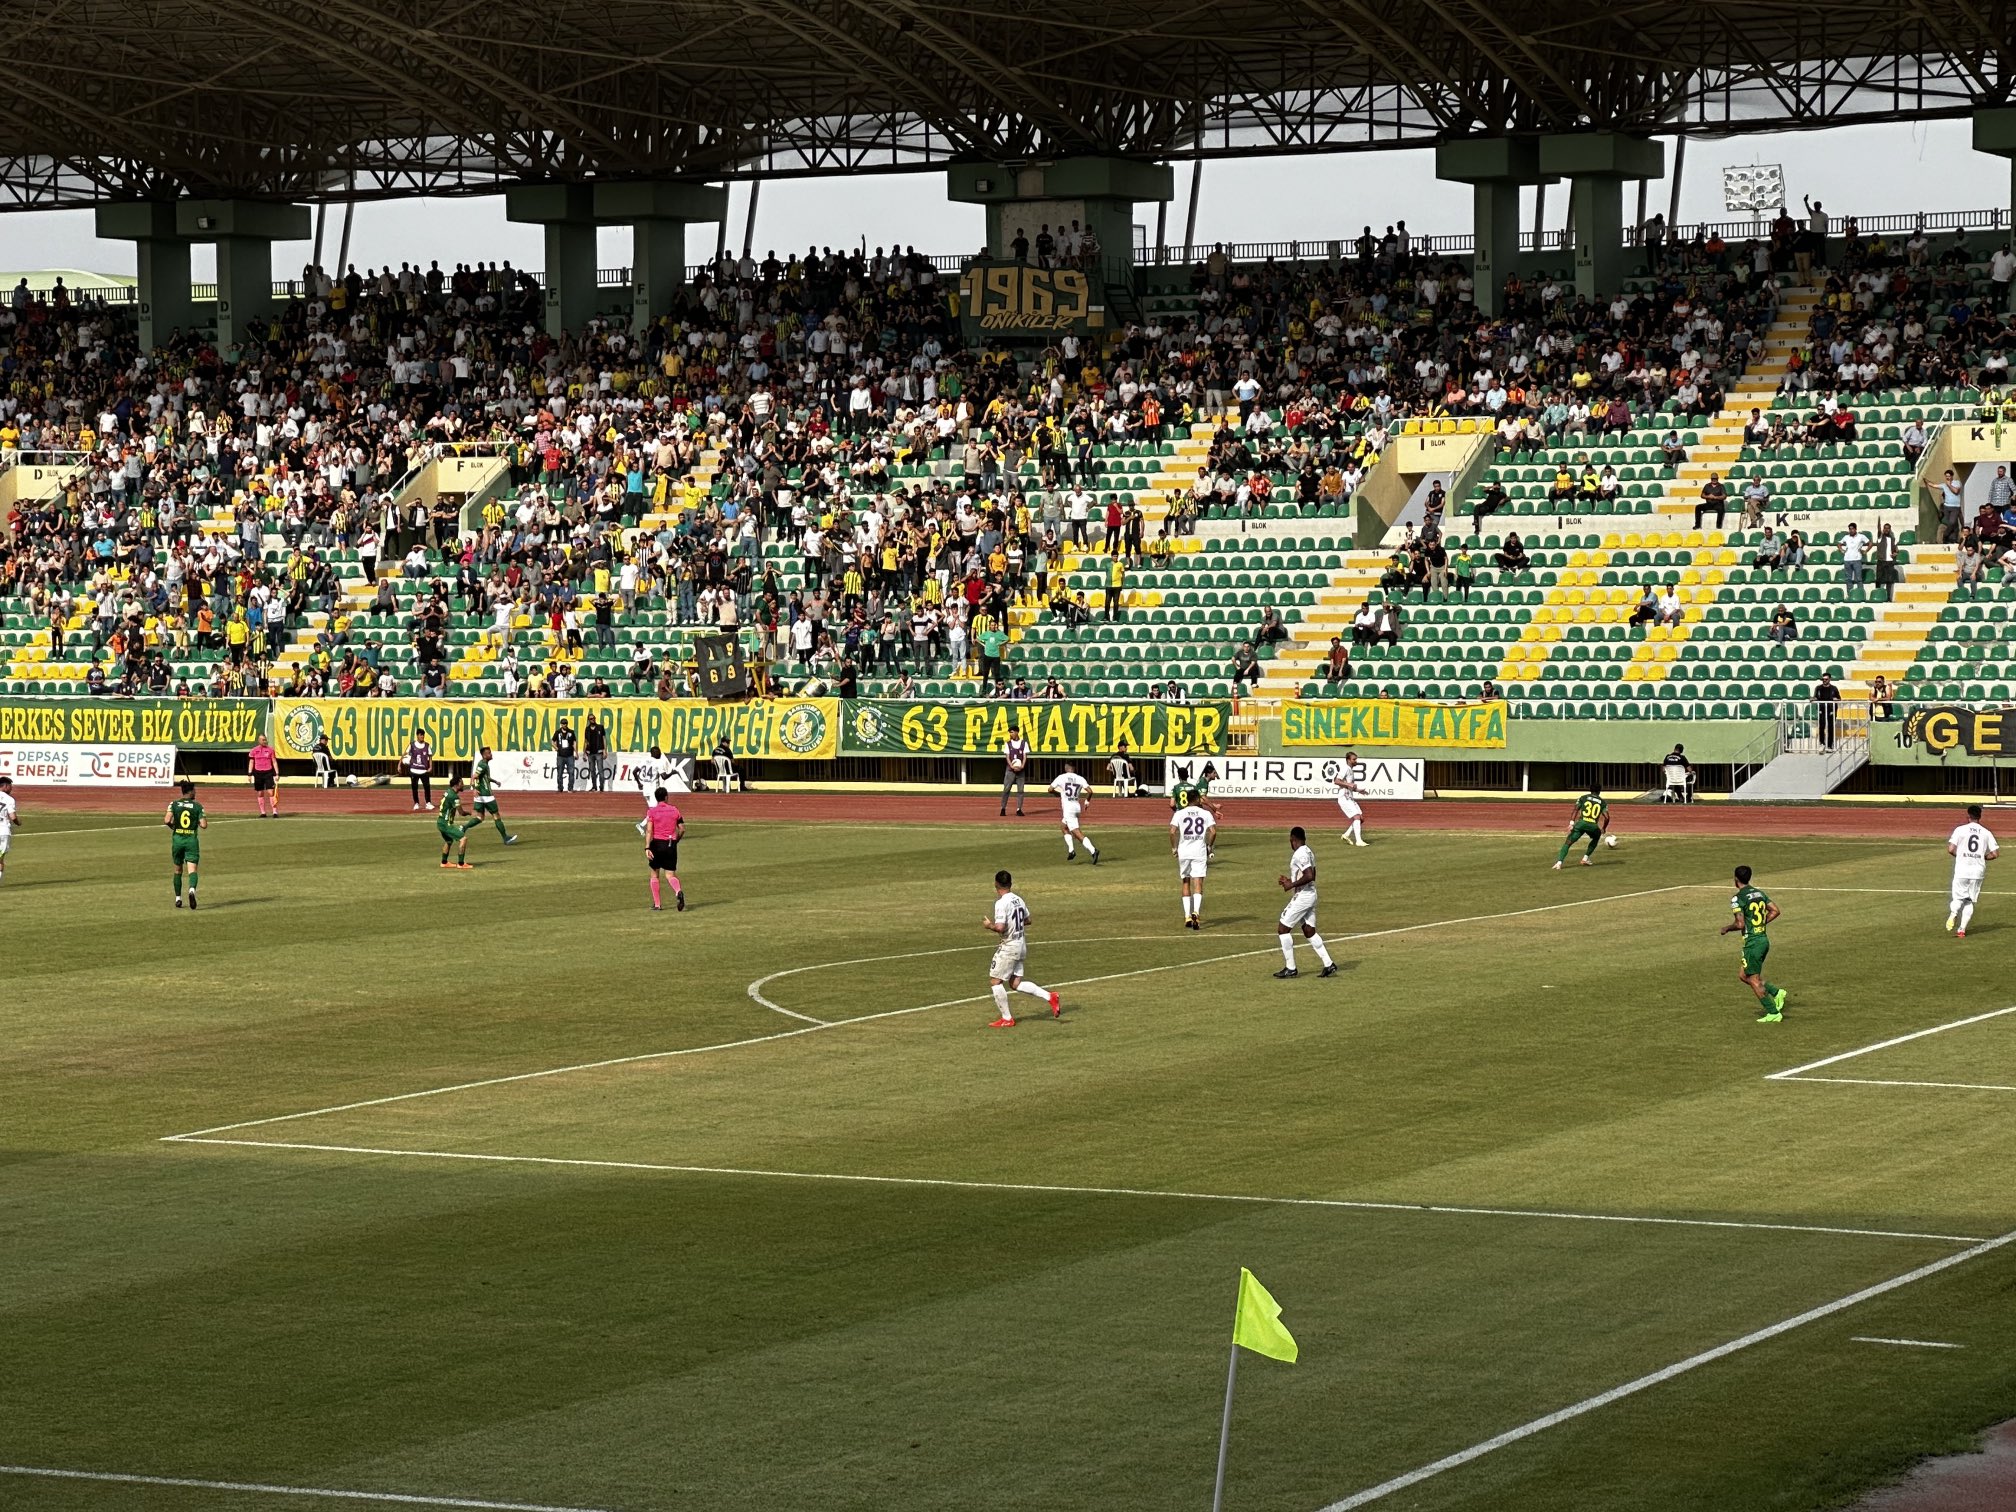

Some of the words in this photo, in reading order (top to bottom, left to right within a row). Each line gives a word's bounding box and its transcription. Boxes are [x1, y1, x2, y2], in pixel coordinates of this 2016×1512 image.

[549, 288, 557, 299] F
[638, 284, 646, 295] F
[965, 266, 1089, 318] 1969
[141, 303, 150, 314] D
[221, 301, 229, 312] D
[1971, 427, 1985, 440] K
[457, 461, 465, 472] F
[34, 469, 43, 480] D
[1776, 513, 1789, 526] K
[71, 708, 135, 742] SEVER
[141, 702, 173, 742] BİZ
[179, 703, 257, 743] ÖLÜRÜZ
[902, 706, 949, 752] 63
[1414, 706, 1504, 741] TAYFA
[331, 707, 357, 756] 63
[367, 706, 485, 757] URFASPOR
[17, 751, 69, 764] DEPSAŞ
[117, 752, 171, 765] DEPSAŞ
[1064, 782, 1080, 797] 57
[1179, 790, 1188, 806] 8
[1582, 801, 1601, 819] 30
[180, 810, 191, 829] 6
[1183, 816, 1205, 835] 28
[1968, 834, 1979, 853] 6
[1012, 907, 1025, 932] 19
